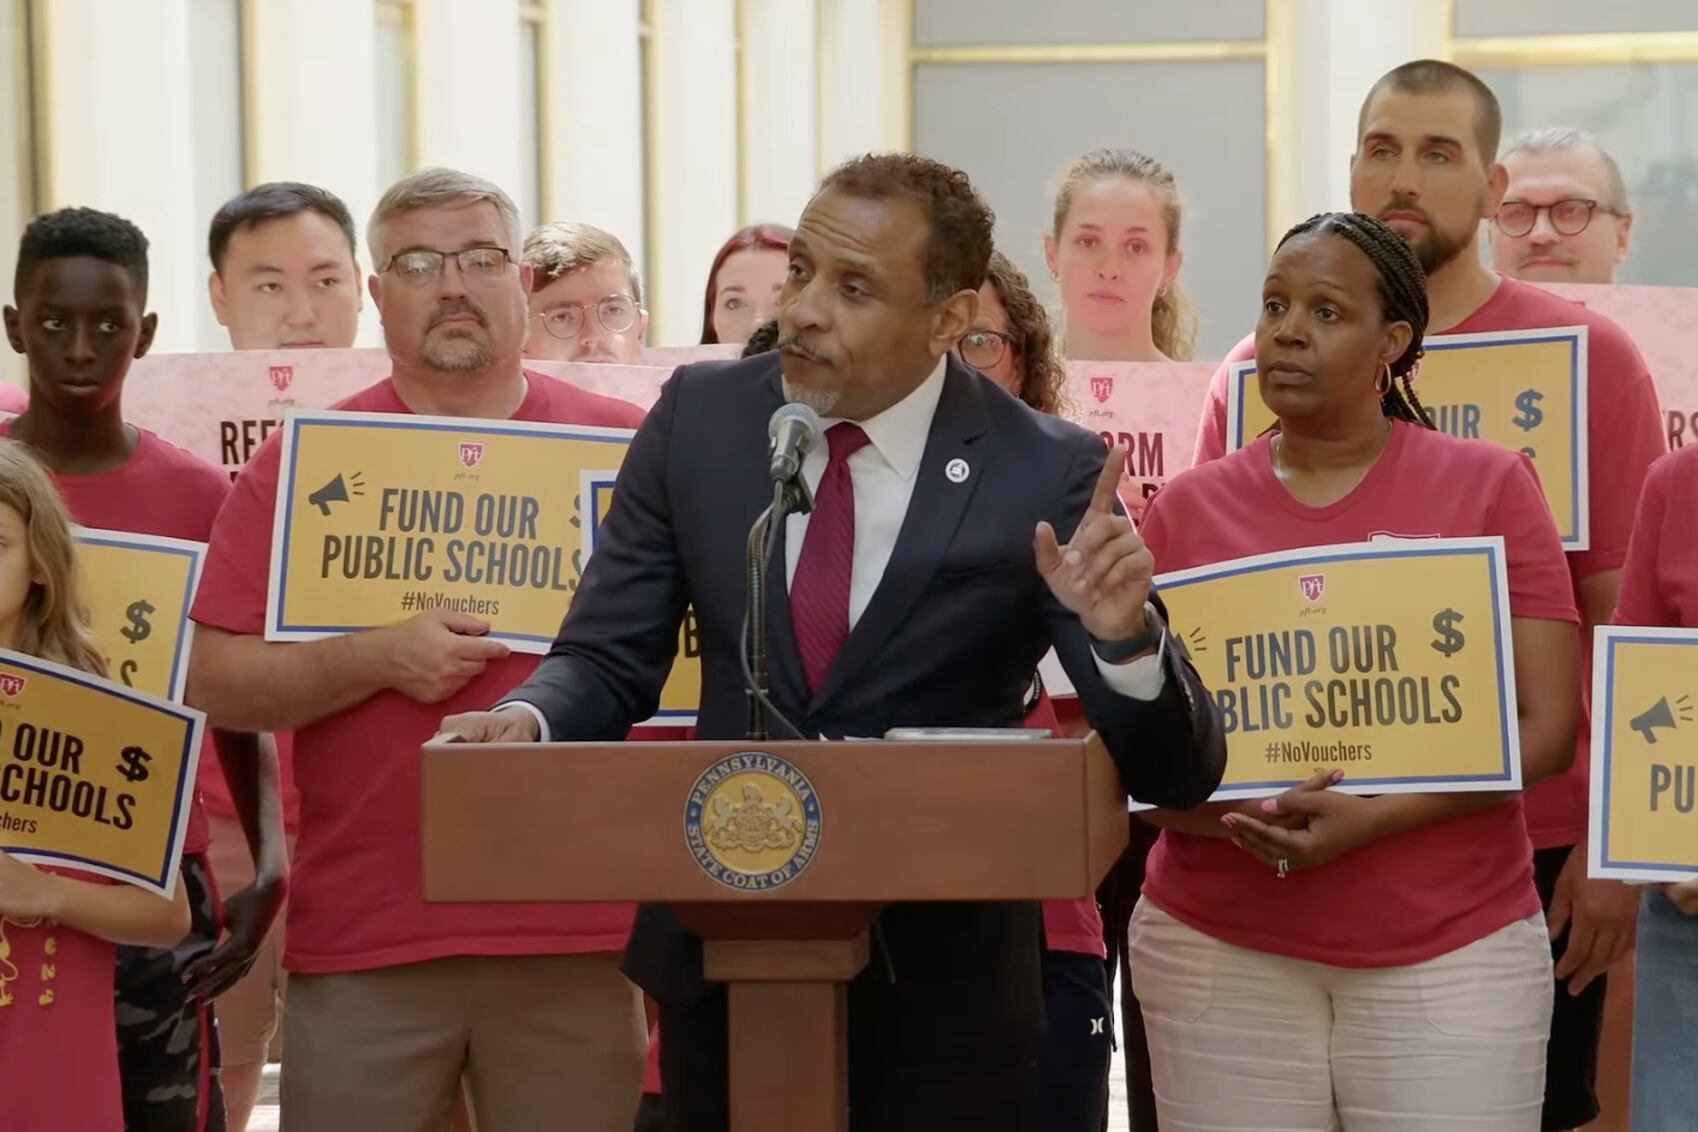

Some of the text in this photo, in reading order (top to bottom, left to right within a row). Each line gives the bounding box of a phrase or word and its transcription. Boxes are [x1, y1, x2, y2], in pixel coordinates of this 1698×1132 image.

[379, 488, 464, 534] FUND
[475, 493, 539, 540] OUR
[321, 535, 434, 581] PUBLIC
[401, 592, 500, 615] #NoVouchers
[1225, 625, 1399, 683] FUND OUR
[1217, 675, 1463, 735] BLIC SCHOOLS
[13, 723, 84, 775] OUR
[1265, 741, 1373, 764] #NoVouchers
[0, 763, 136, 830] CHOOLS
[692, 755, 812, 805] PENNSYLVANIA
[688, 821, 819, 889] STATE COAT OF ARMS
